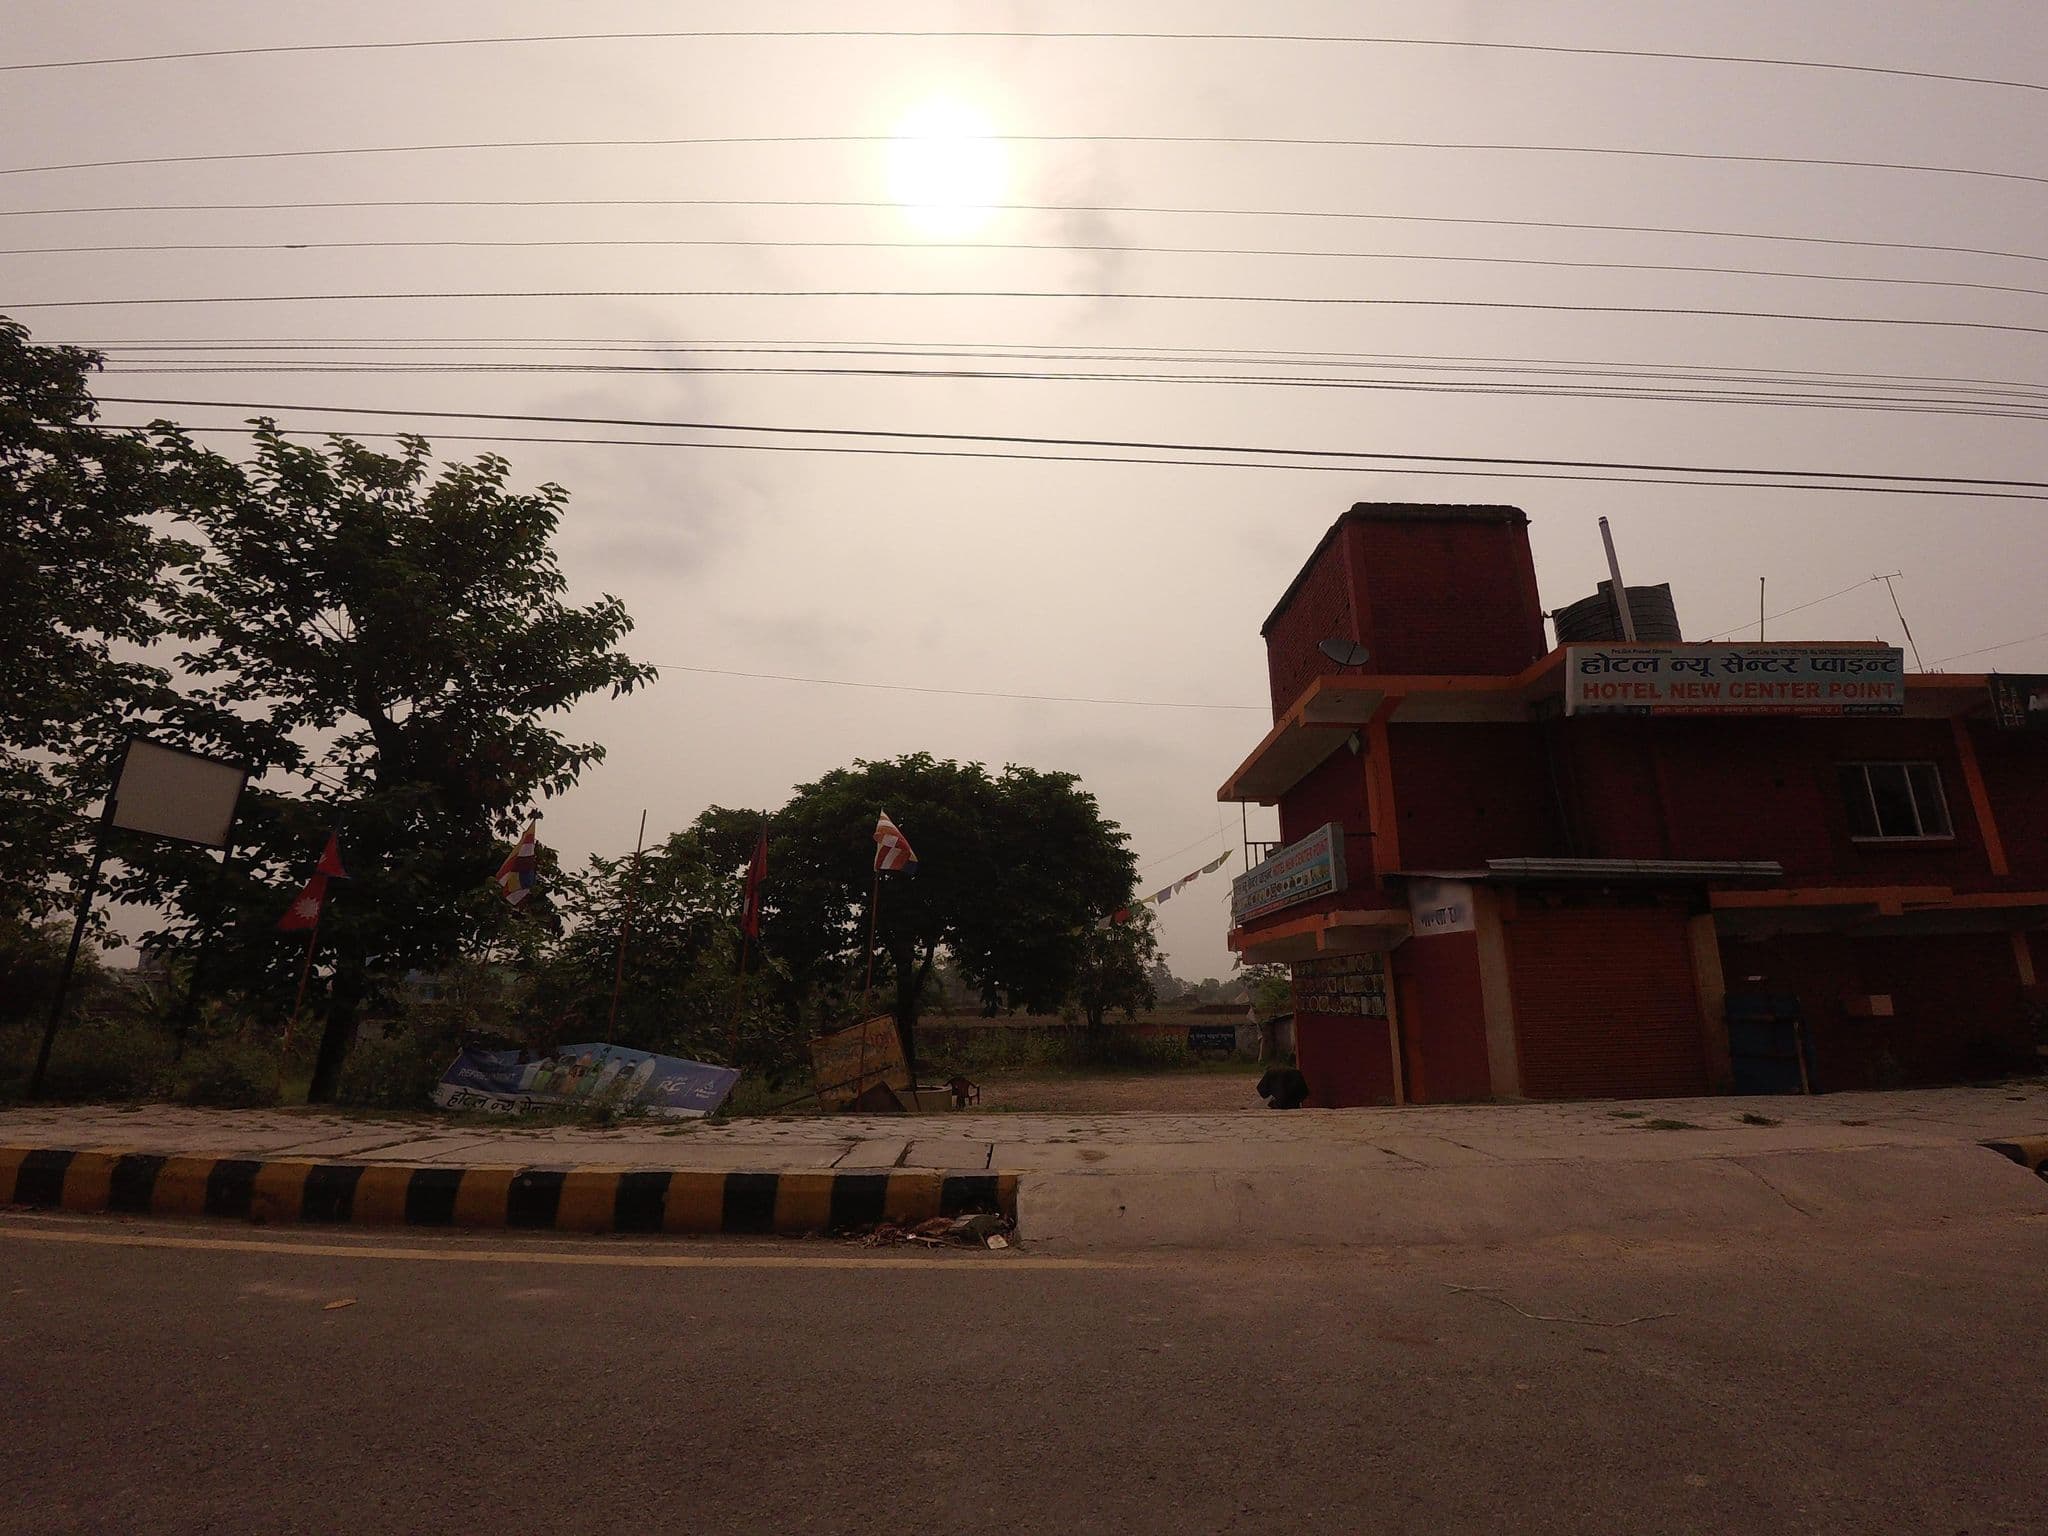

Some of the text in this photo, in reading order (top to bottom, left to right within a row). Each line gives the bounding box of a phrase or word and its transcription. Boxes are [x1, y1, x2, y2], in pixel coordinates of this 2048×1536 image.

[1581, 652, 1898, 677] होटल न्यू सेन्टर प्वाइन्ट
[1583, 682, 1896, 699] HOTEL NEW CENTER POINT
